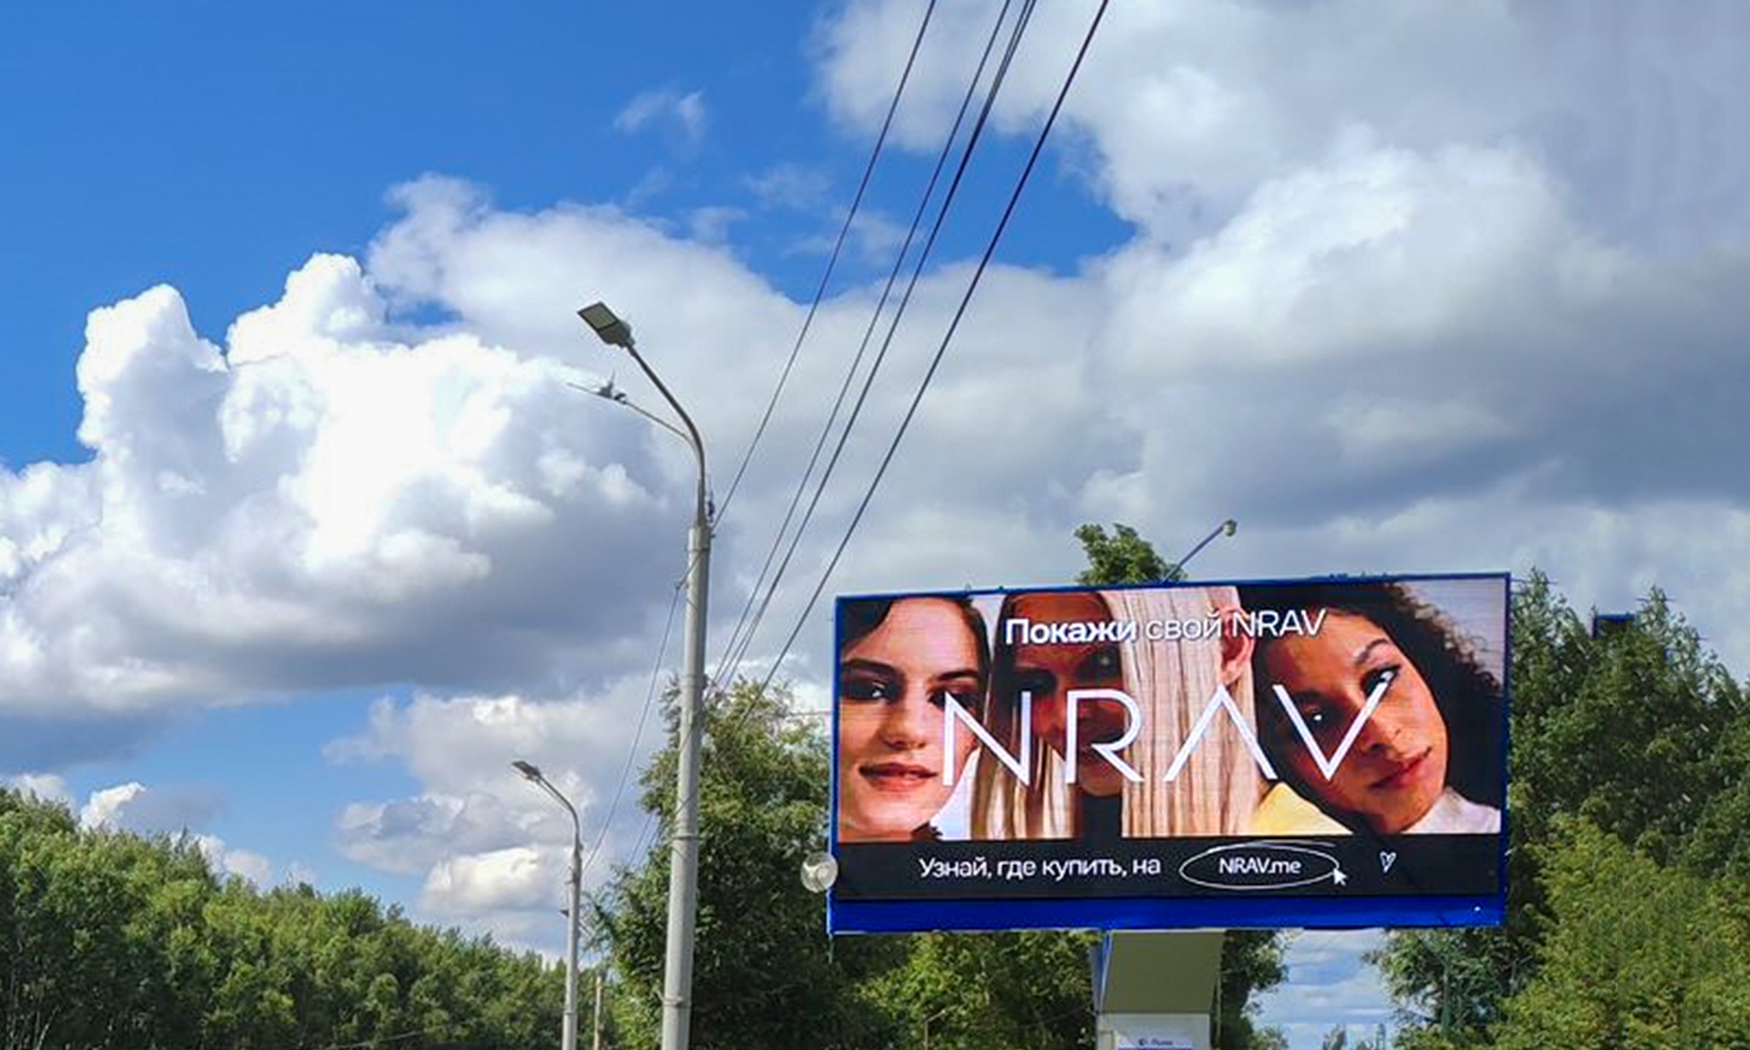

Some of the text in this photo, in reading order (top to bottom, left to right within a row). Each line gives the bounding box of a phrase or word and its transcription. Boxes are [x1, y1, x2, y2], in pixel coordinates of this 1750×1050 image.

[1005, 609, 1327, 646] Покажи свой NRAV
[942, 683, 1389, 786] NRAV
[919, 857, 992, 878] Узнай,
[997, 860, 1037, 880] где
[1042, 859, 1128, 881] купить,
[1132, 858, 1162, 874] на
